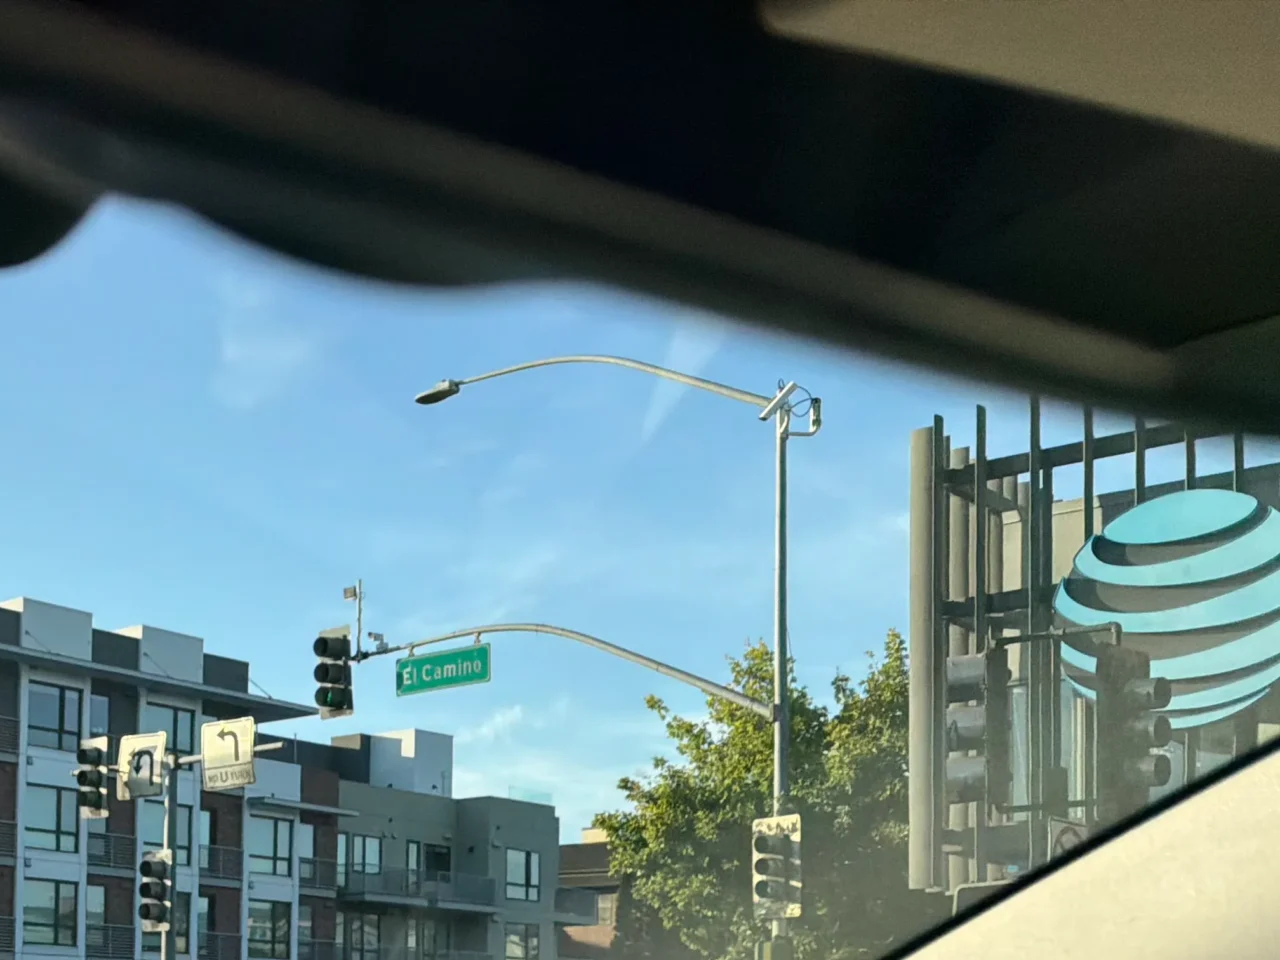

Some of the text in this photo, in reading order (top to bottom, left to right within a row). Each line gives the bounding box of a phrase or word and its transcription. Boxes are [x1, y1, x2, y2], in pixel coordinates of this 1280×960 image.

[403, 659, 482, 685] El Camino
[220, 770, 229, 783] U
